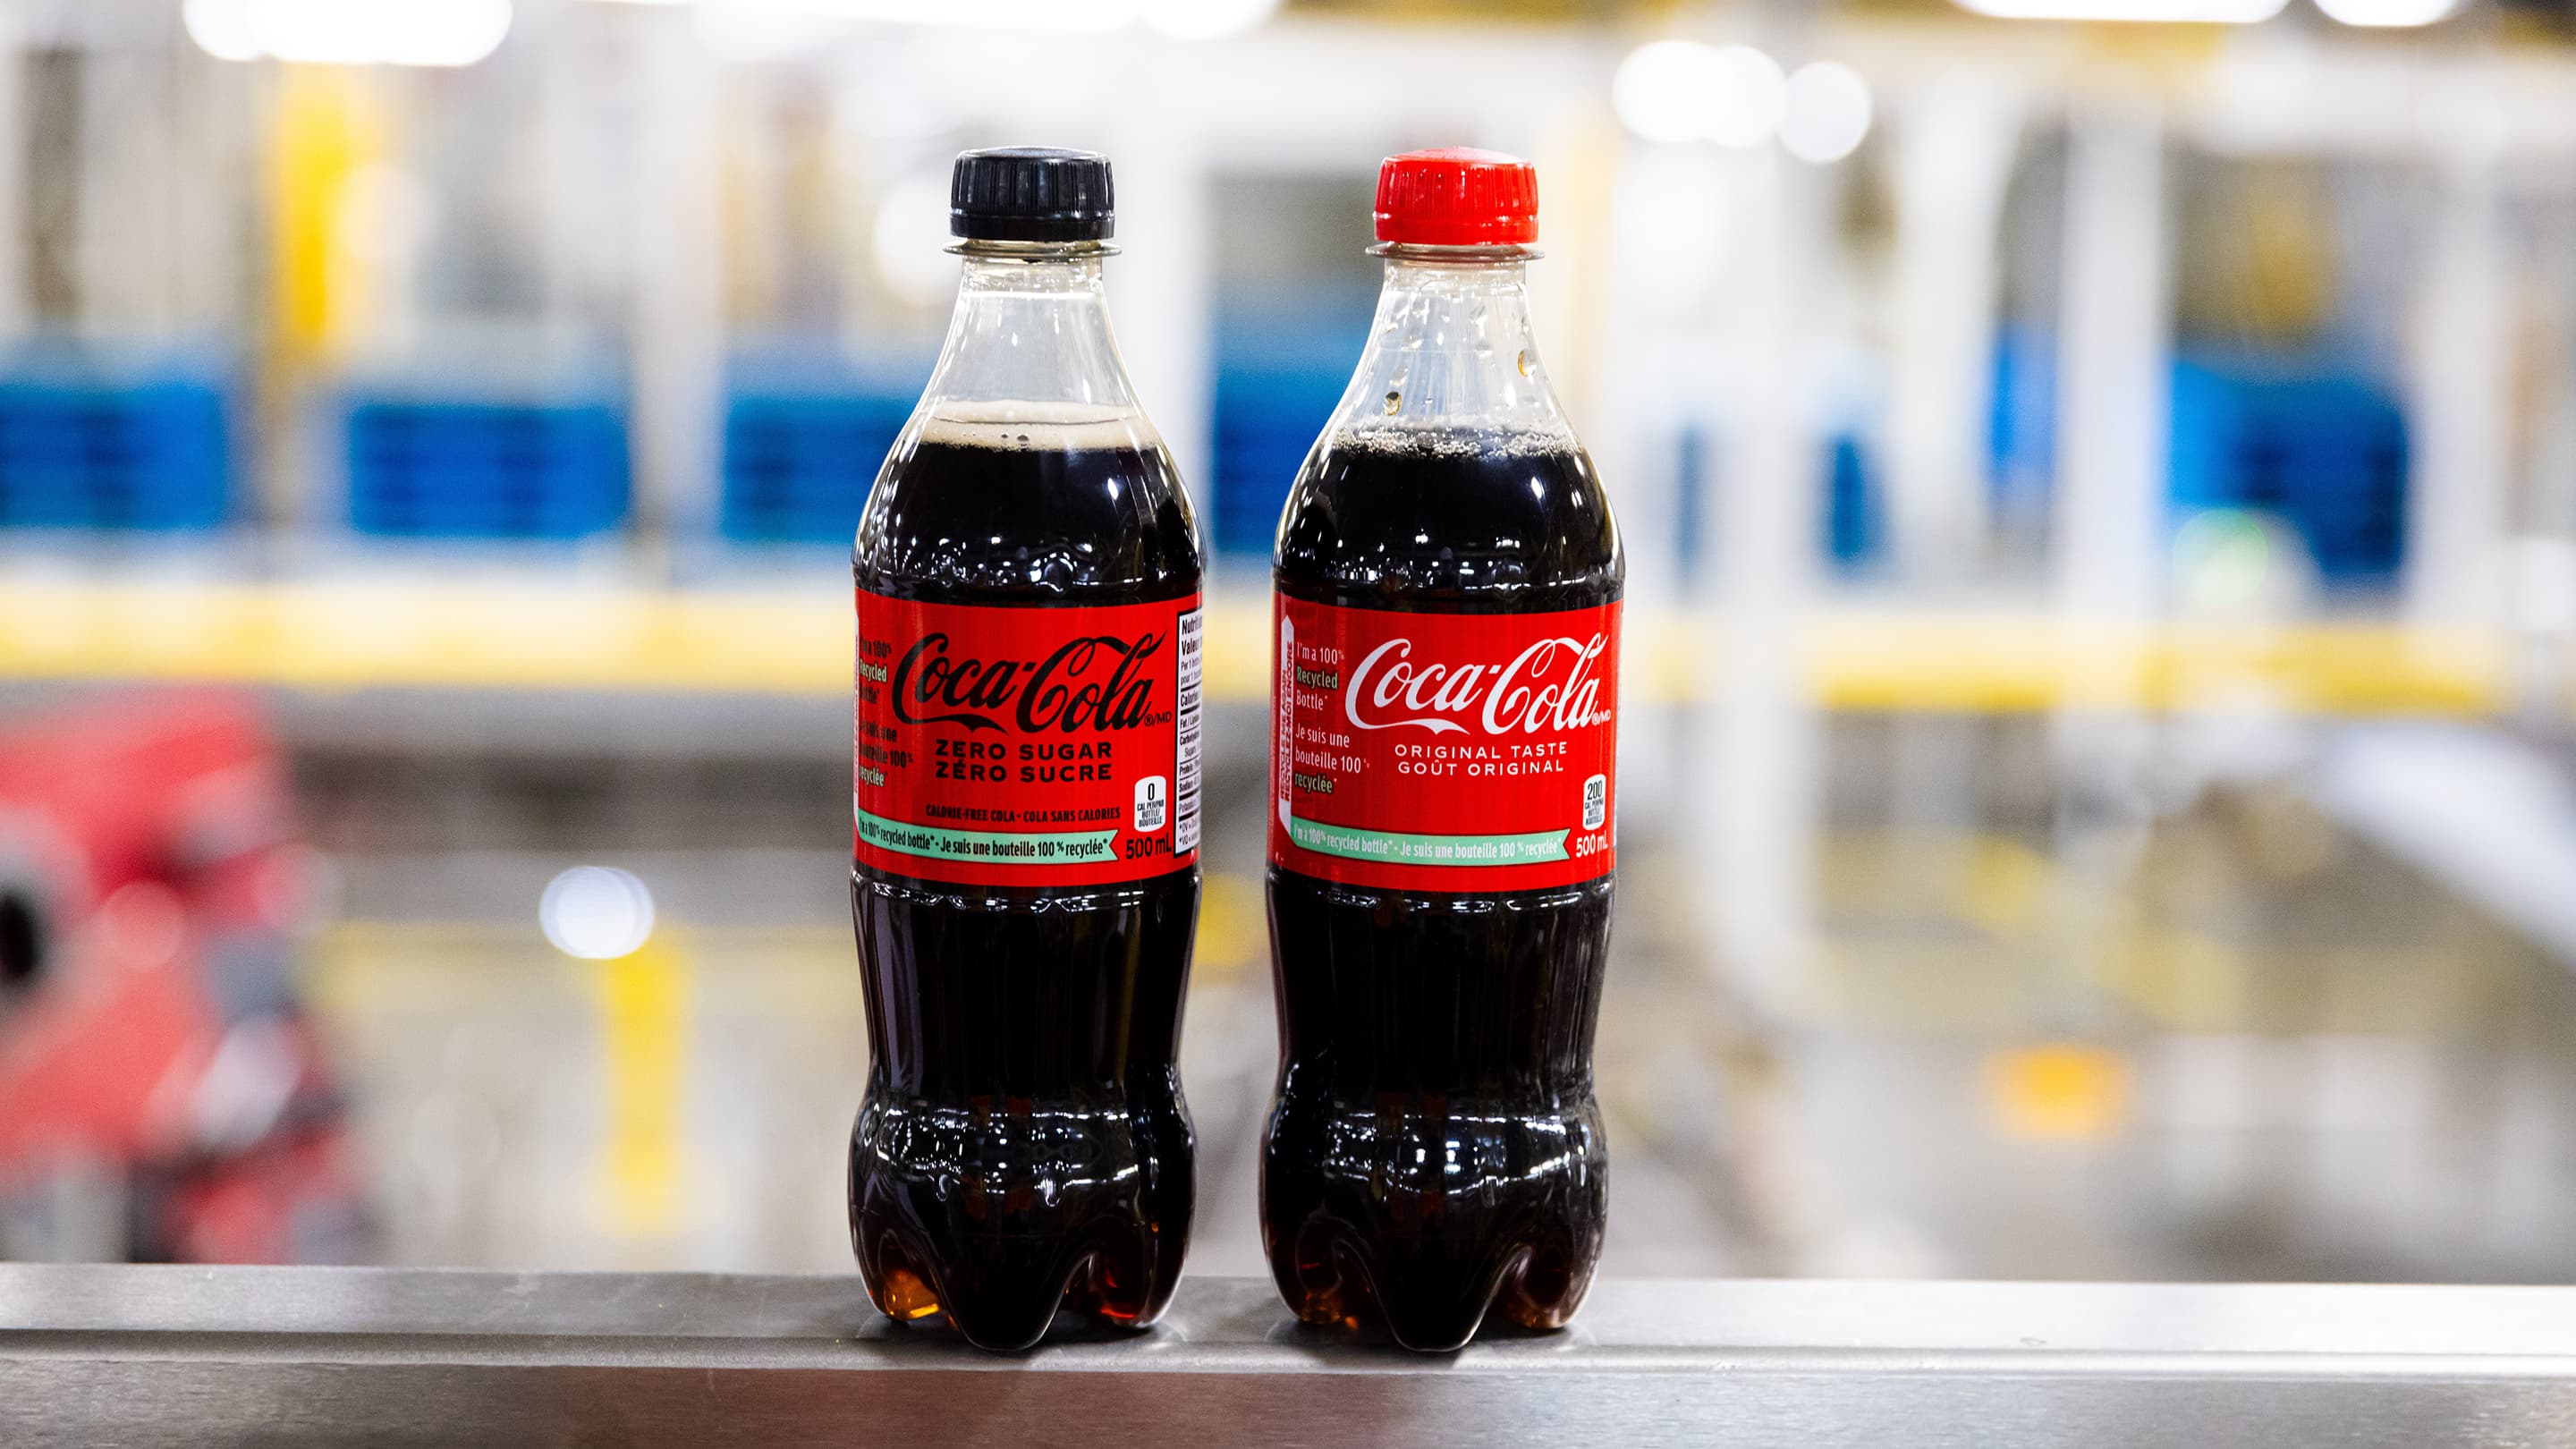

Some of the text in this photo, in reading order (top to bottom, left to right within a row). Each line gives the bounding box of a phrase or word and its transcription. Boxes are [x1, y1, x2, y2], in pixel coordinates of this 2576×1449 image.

[1297, 641, 1309, 660] I'm
[1311, 648, 1317, 661] a
[893, 630, 1166, 735] Coca-Cola
[1297, 665, 1338, 690] Recycled
[1345, 632, 1608, 734] Coca-Cola
[1295, 723, 1350, 748] Je suis une
[936, 739, 1112, 760] ZERO SUGAR
[1295, 745, 1337, 770] bouteille
[1394, 741, 1567, 759] ORIGINAL TASTE
[936, 758, 1112, 783] ZÉRO SUCRE
[1398, 759, 1563, 776] GOÛT ORIGINAL
[1148, 783, 1155, 801] 0
[1588, 780, 1603, 801] 200
[926, 804, 1121, 823] CALORIE-FREE COLA COLA SANS CALORIES
[881, 828, 906, 846] recycled
[940, 836, 951, 852] Je
[953, 838, 971, 854] suis
[973, 843, 990, 855] une
[992, 839, 1035, 856] bouteille
[1126, 832, 1172, 860] 500 mL
[1327, 835, 1360, 852] recycled
[1400, 840, 1411, 856] Je
[1413, 842, 1432, 858] suis
[1435, 844, 1453, 859] une
[1455, 843, 1497, 859] bouteille
[1576, 830, 1608, 858] 500 mL
